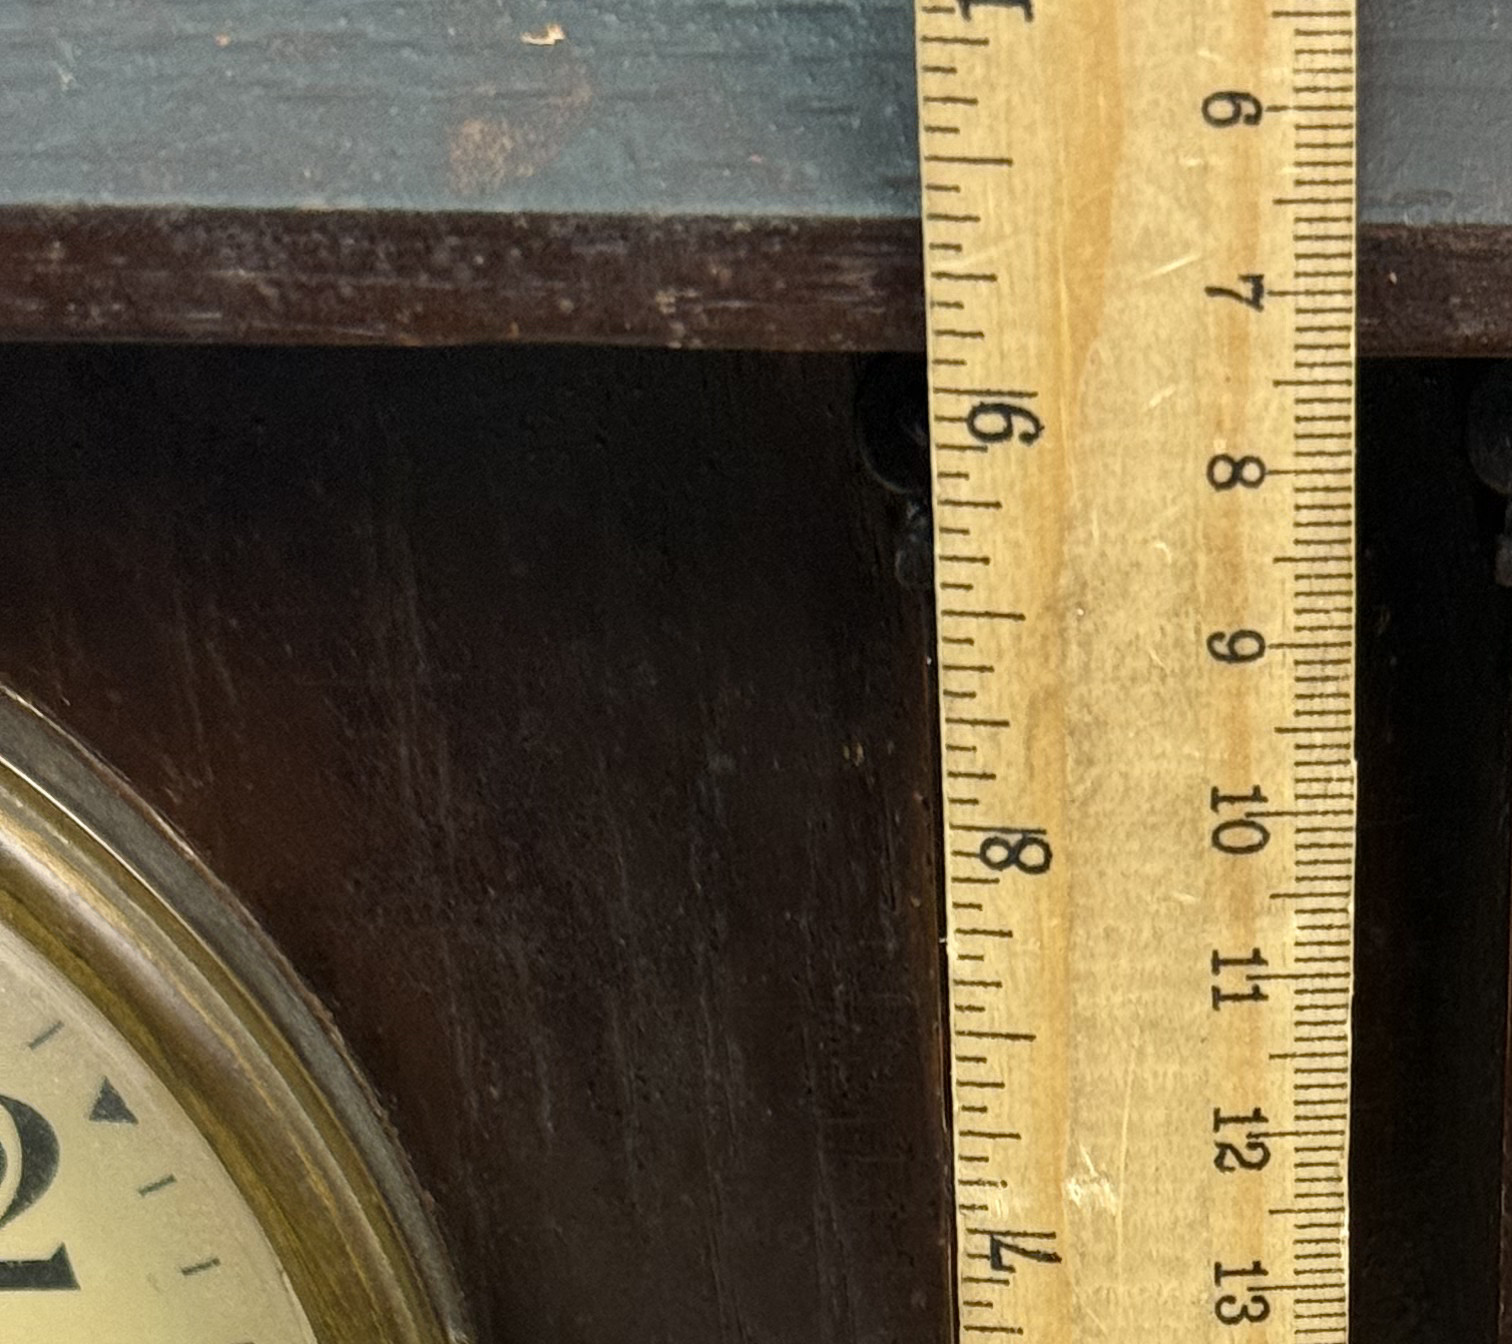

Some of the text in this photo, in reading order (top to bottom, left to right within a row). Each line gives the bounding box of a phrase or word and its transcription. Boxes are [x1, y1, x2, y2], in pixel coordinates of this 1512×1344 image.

[1200, 91, 1264, 127] 6
[1204, 273, 1265, 312] 7
[965, 401, 1045, 445] 9
[1205, 454, 1267, 491] 8
[1205, 628, 1267, 664] 9
[1208, 785, 1271, 856] 10
[978, 835, 1052, 875] 8
[1210, 947, 1268, 1012] 11
[1212, 1106, 1272, 1173] 12
[990, 1230, 1062, 1273] 7
[1213, 1260, 1271, 1327] 13
